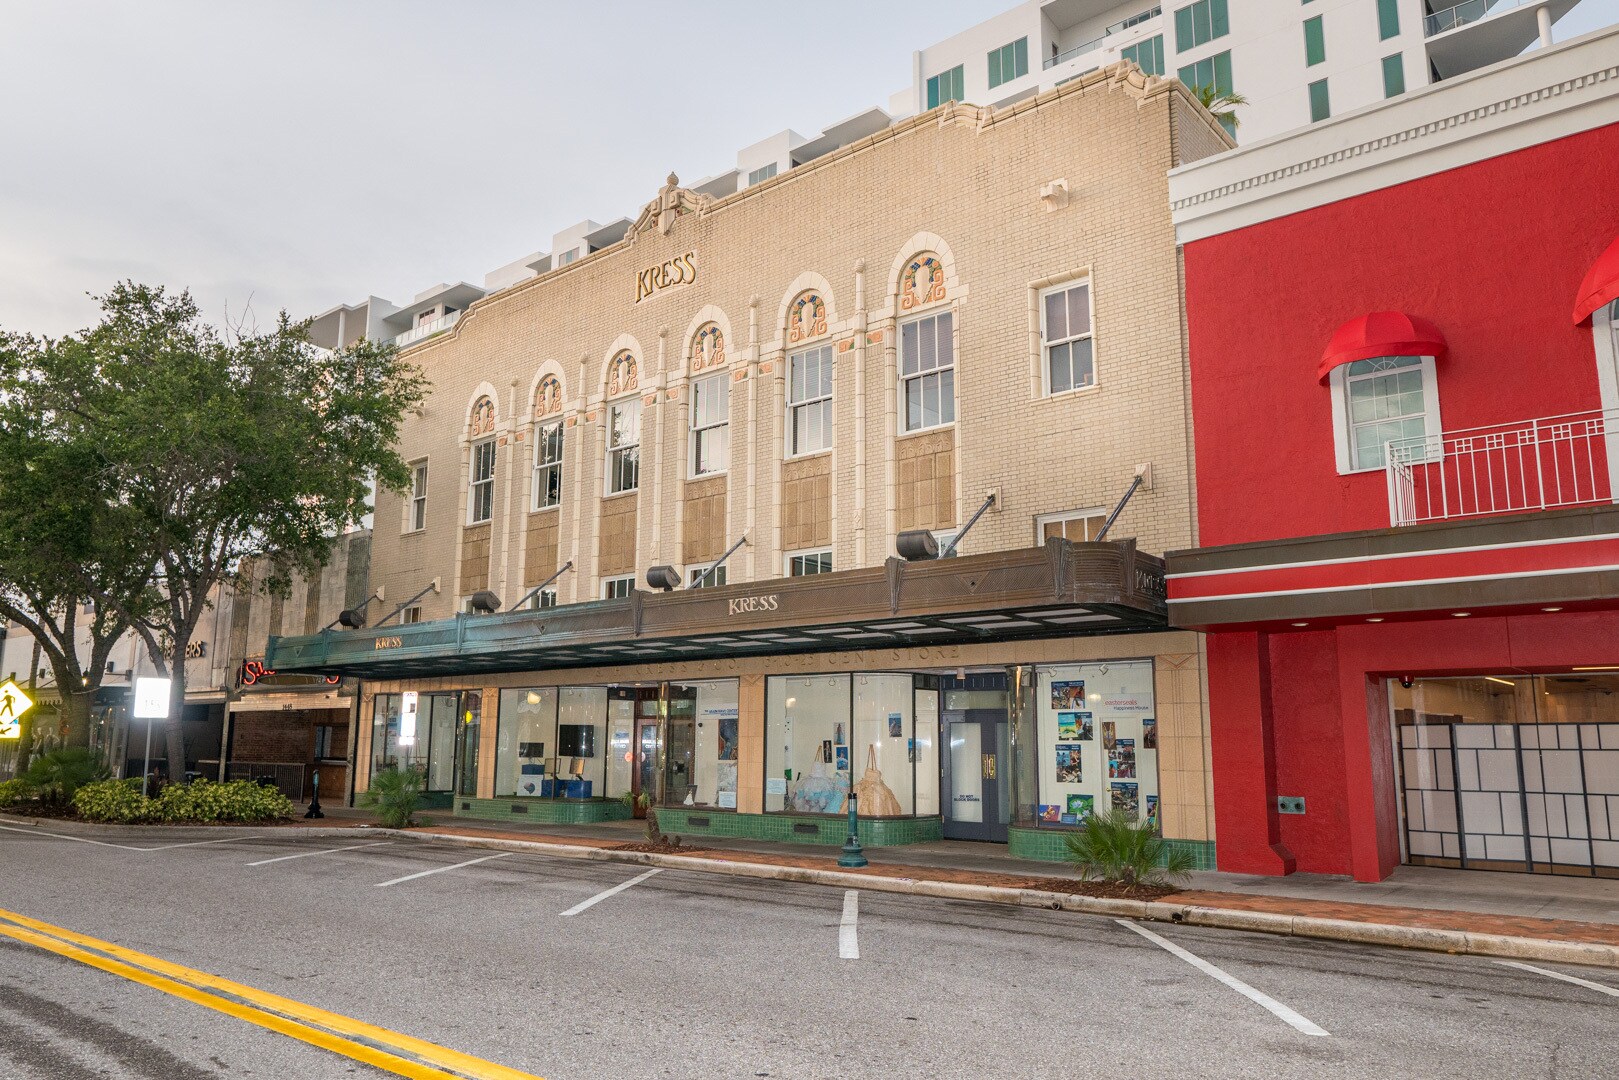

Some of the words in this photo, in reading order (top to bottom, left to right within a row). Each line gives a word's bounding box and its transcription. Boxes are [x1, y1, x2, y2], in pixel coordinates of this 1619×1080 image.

[635, 252, 696, 304] KRESS
[728, 594, 779, 616] KRESS
[375, 636, 403, 650] KRESS
[892, 645, 960, 662] STORE
